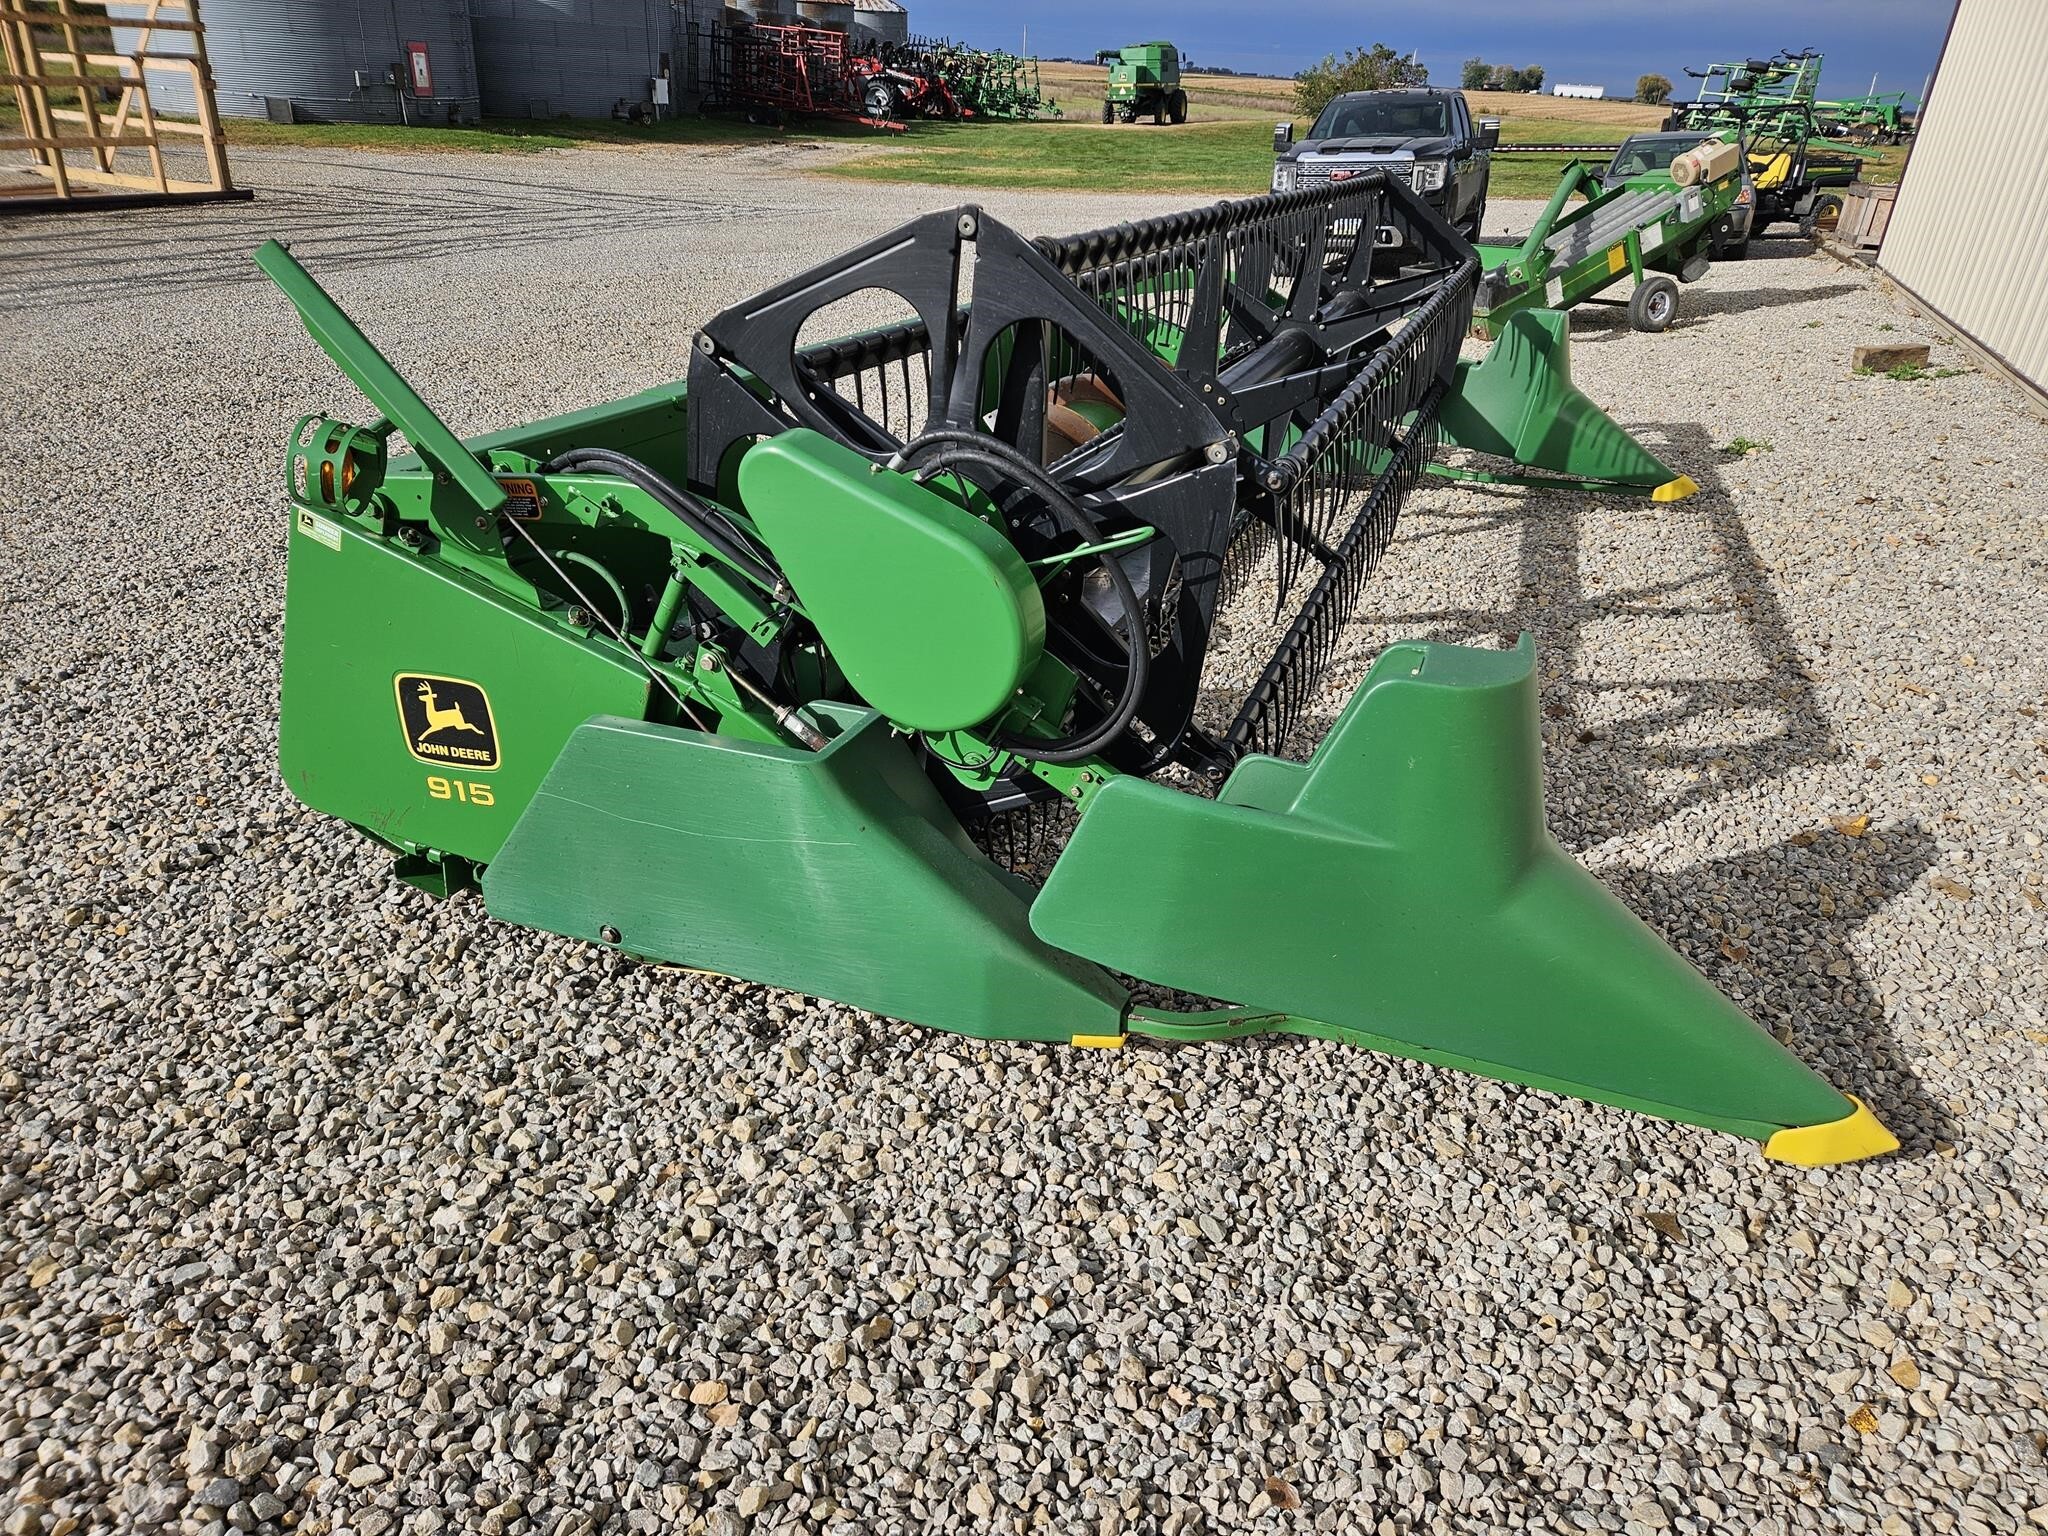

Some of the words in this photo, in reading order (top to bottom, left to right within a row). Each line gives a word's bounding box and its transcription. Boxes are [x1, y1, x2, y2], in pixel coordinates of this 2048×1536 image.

[501, 483, 533, 494] NING
[417, 742, 449, 756] JOHN
[450, 746, 491, 761] DEERE
[427, 776, 495, 806] 915
